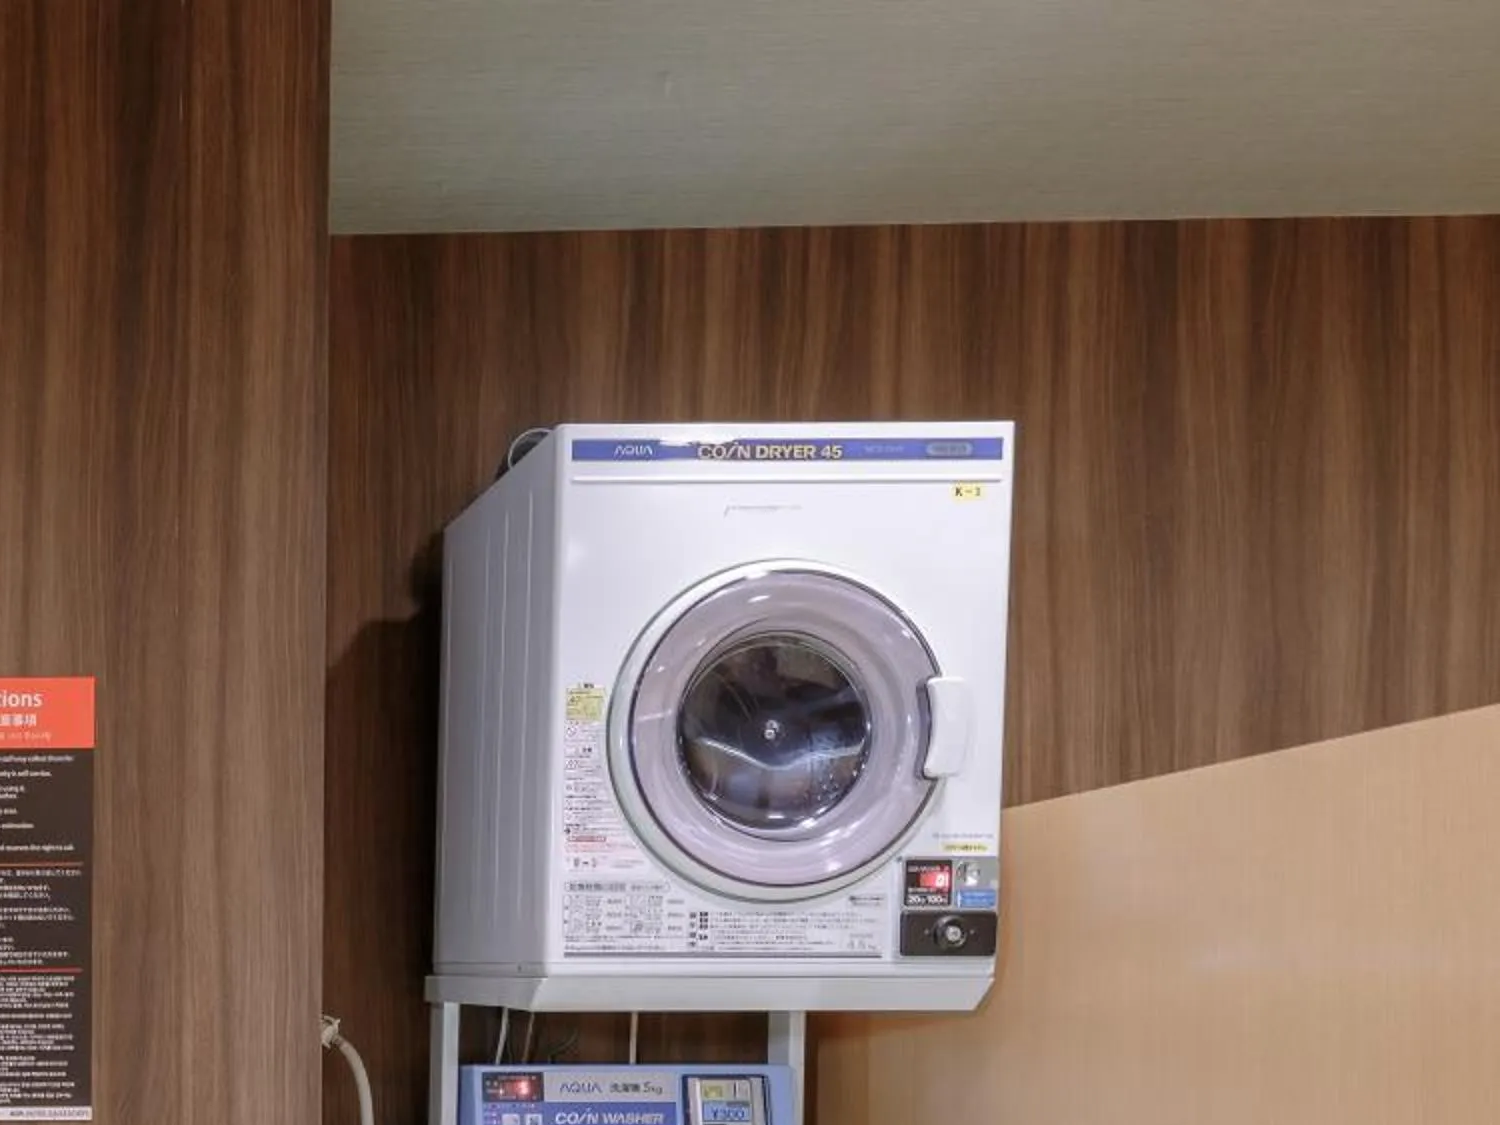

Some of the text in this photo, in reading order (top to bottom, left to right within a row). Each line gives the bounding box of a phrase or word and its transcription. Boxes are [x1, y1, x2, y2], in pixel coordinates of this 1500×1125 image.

[755, 445, 816, 459] DRYER
[820, 445, 843, 459] 45
[560, 1082, 602, 1093] AQUA
[602, 1113, 664, 1125] WASHER
